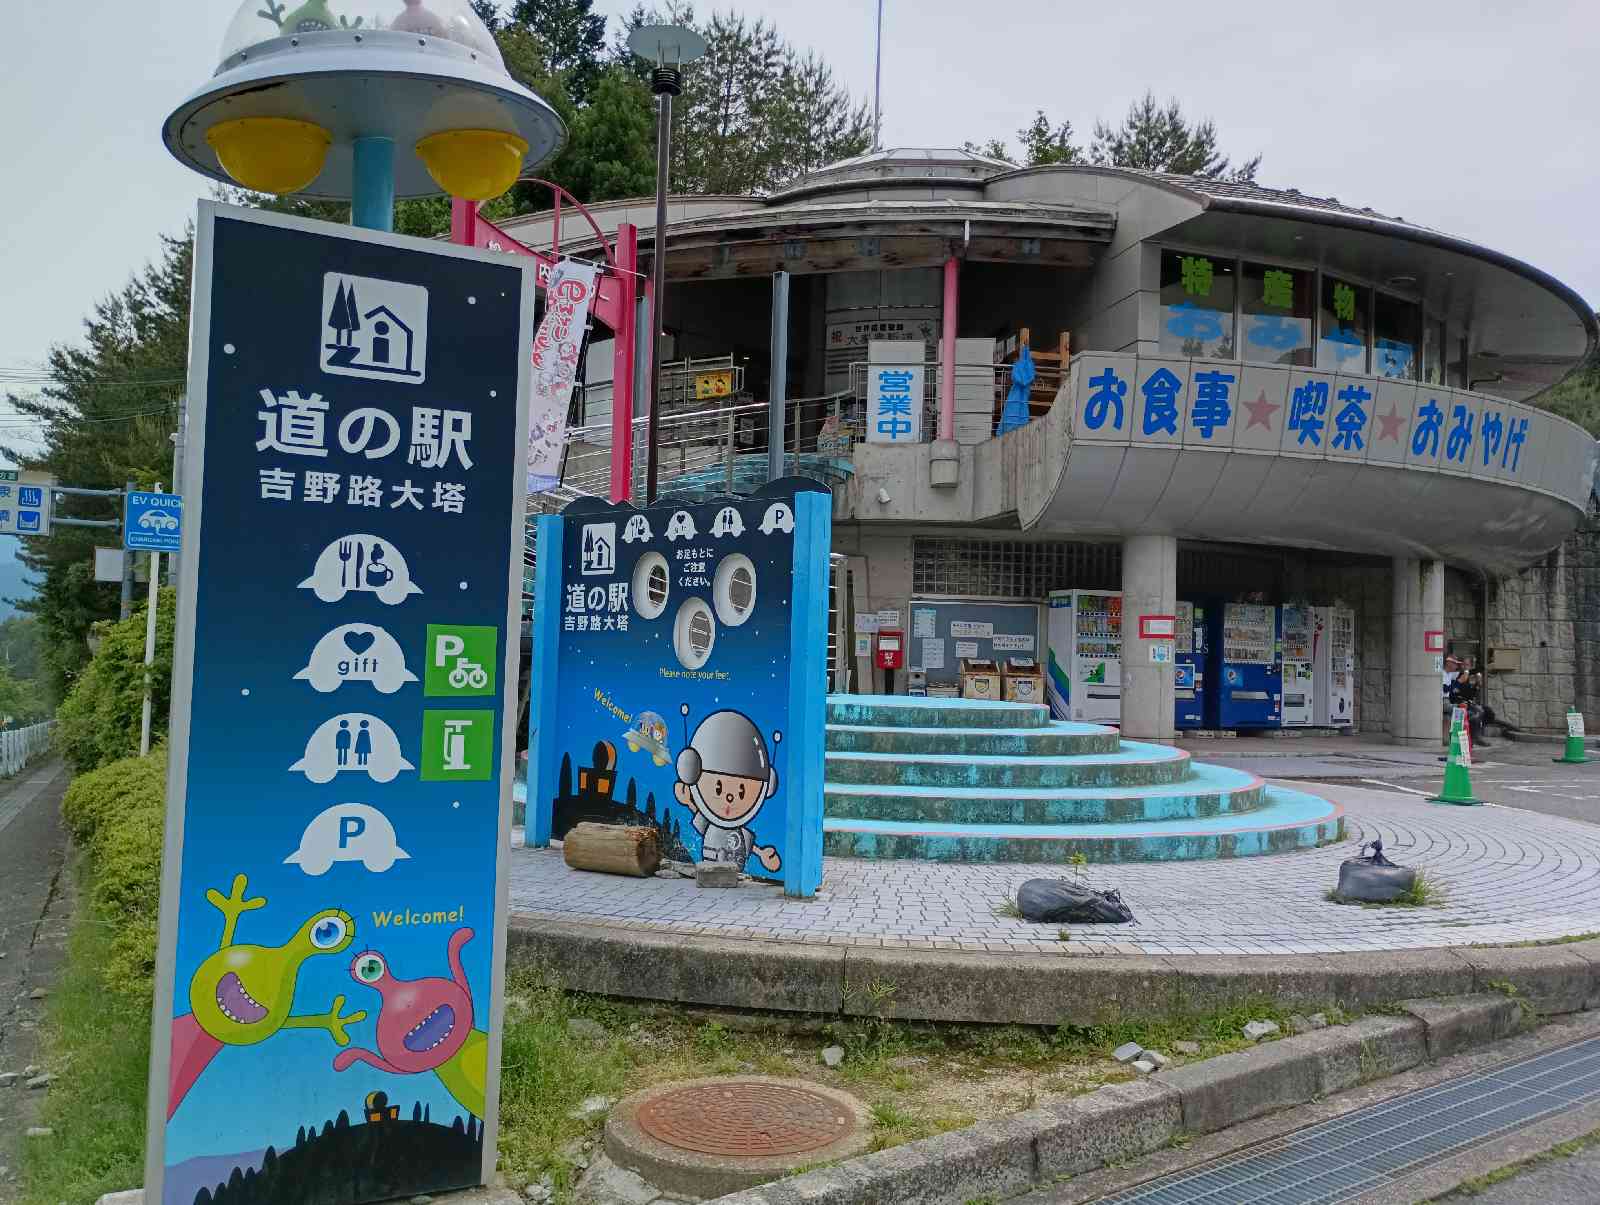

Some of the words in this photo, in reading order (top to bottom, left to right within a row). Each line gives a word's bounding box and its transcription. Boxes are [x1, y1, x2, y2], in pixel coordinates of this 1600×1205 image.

[877, 369, 914, 440] 営業中
[1083, 367, 1236, 439] お食事
[1287, 379, 1372, 451] 喫茶
[1411, 399, 1529, 473] おみやげ
[255, 387, 475, 471] 道の駅
[132, 495, 147, 505] EV
[258, 466, 467, 514] 吉野路大塔
[774, 509, 785, 523] P
[676, 547, 714, 560] お足もとに
[565, 582, 629, 613] 道の駅
[564, 614, 629, 632] 吉野路大塔
[336, 657, 380, 675] gift
[434, 634, 465, 667] P
[659, 666, 680, 679] Please
[681, 671, 697, 679] note
[697, 671, 714, 681] your
[593, 687, 634, 724] Welcome!
[338, 816, 366, 849] P
[371, 905, 466, 929] Welcome!
